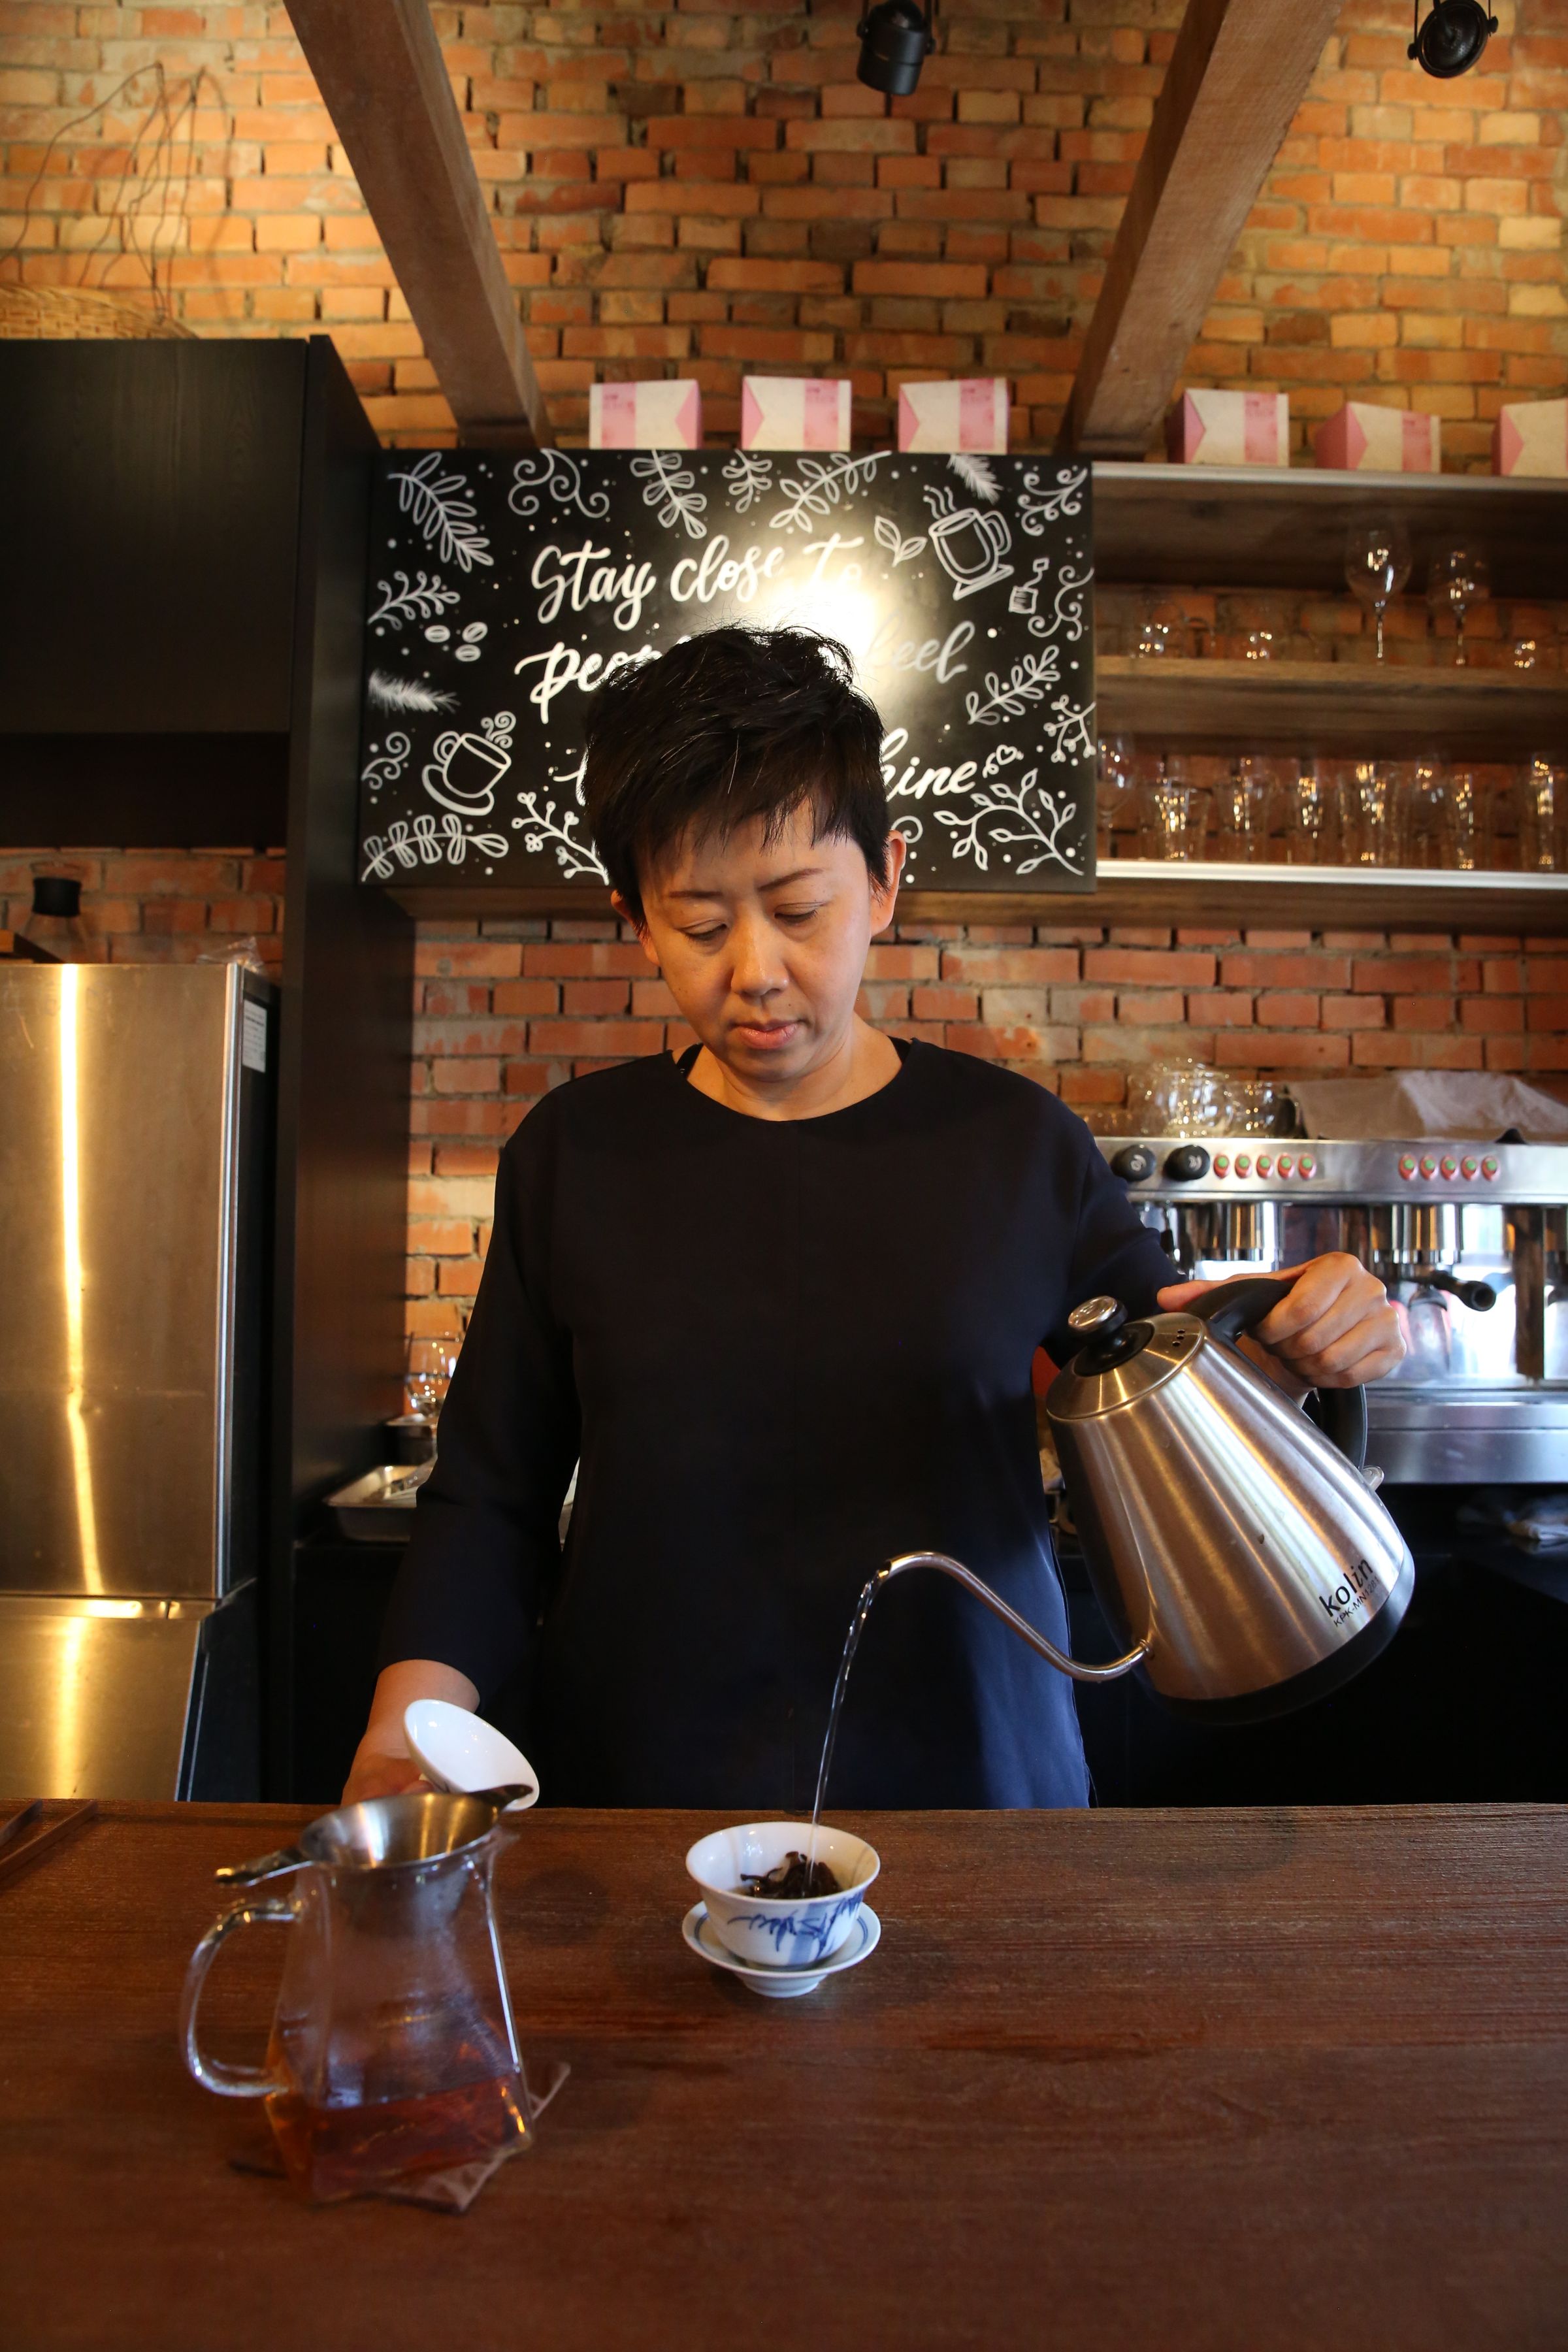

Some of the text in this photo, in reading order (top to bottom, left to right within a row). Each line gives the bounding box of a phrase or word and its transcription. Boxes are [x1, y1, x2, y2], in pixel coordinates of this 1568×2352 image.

[531, 539, 657, 631] Stay
[670, 534, 785, 603] close
[1318, 1559, 1373, 1618] kolin
